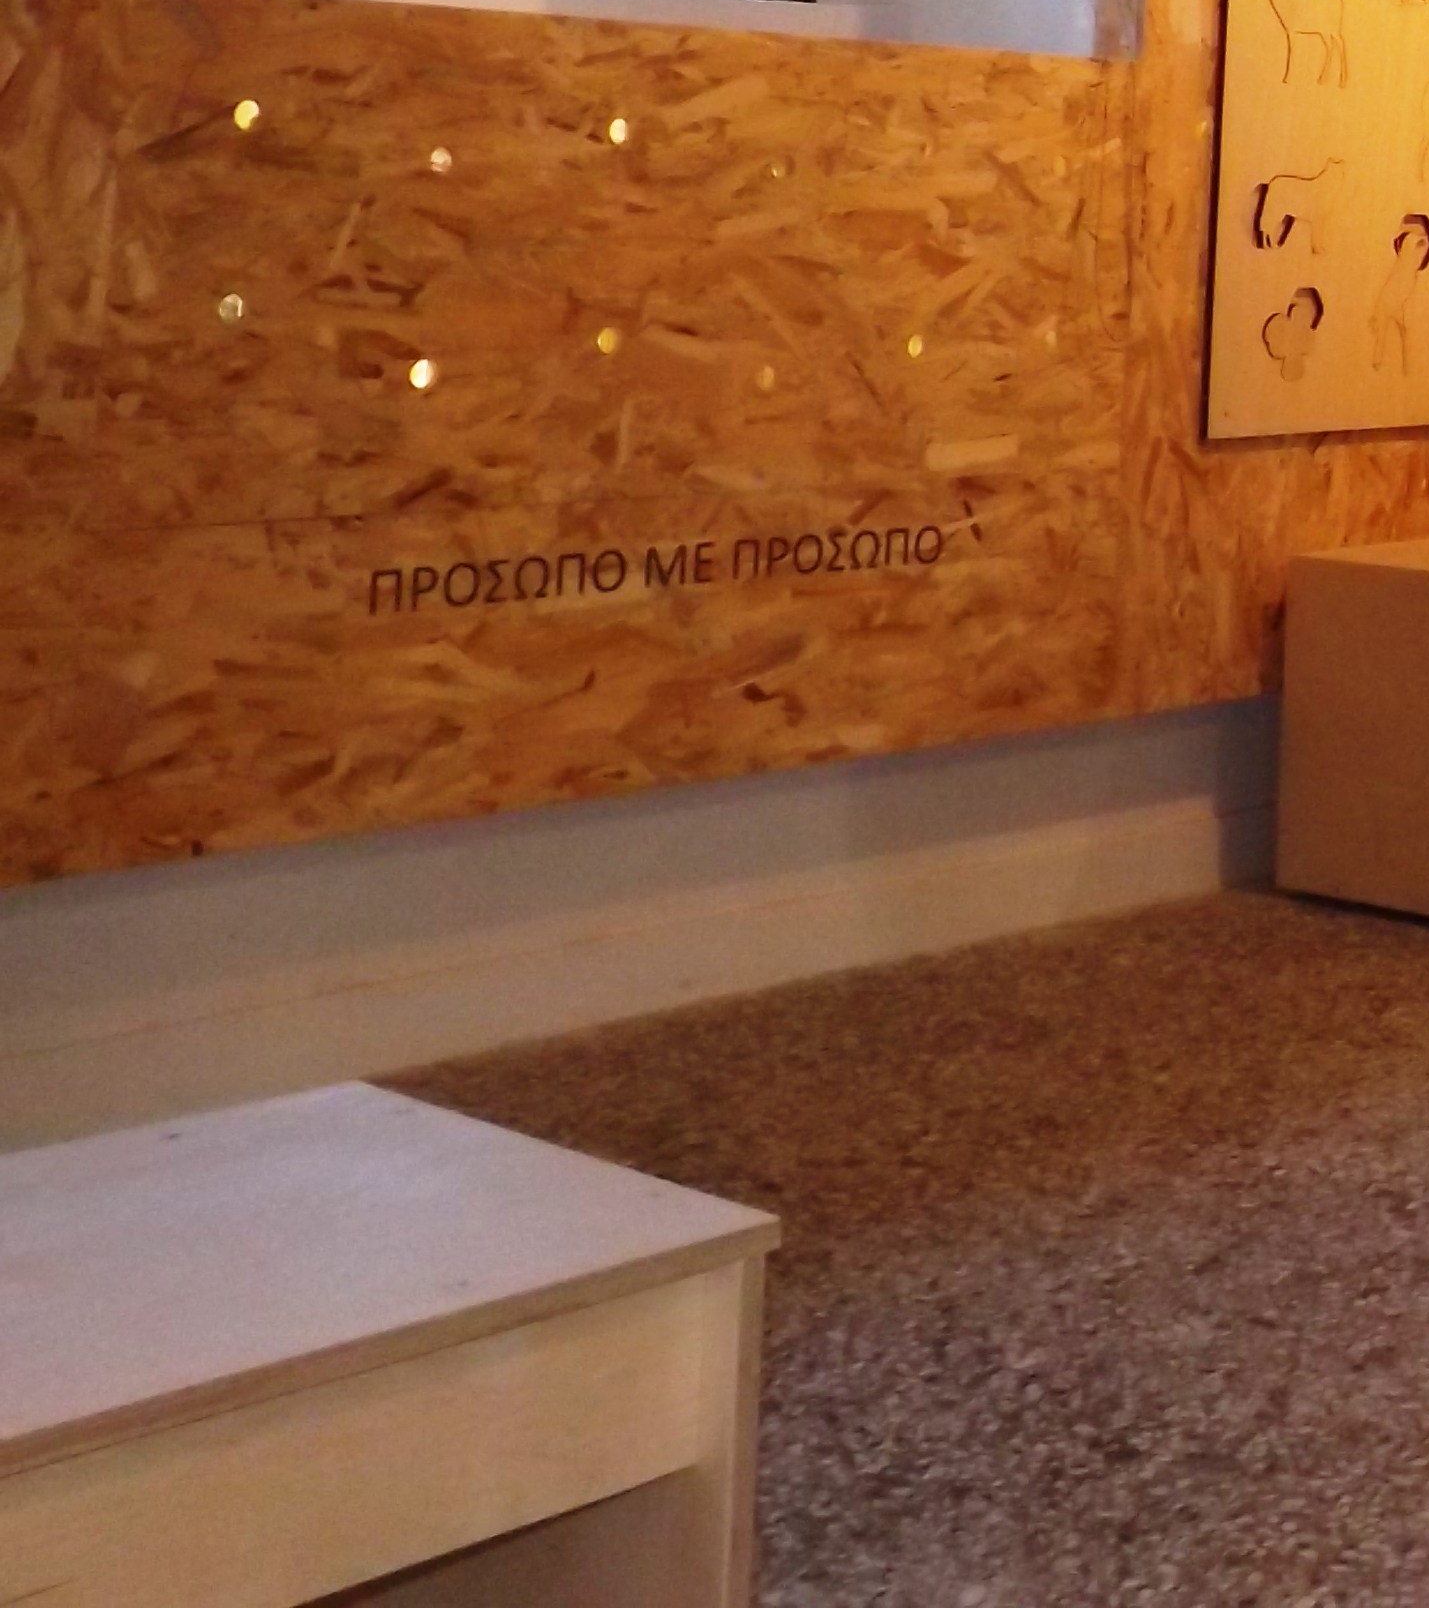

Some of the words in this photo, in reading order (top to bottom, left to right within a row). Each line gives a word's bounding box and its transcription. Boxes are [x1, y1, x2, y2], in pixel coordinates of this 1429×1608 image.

[367, 549, 627, 614] ΠΡΟΣΩΠΟ
[644, 541, 716, 588] ΜΕ
[731, 525, 943, 580] ΠΡΟΣΩΠΟ
